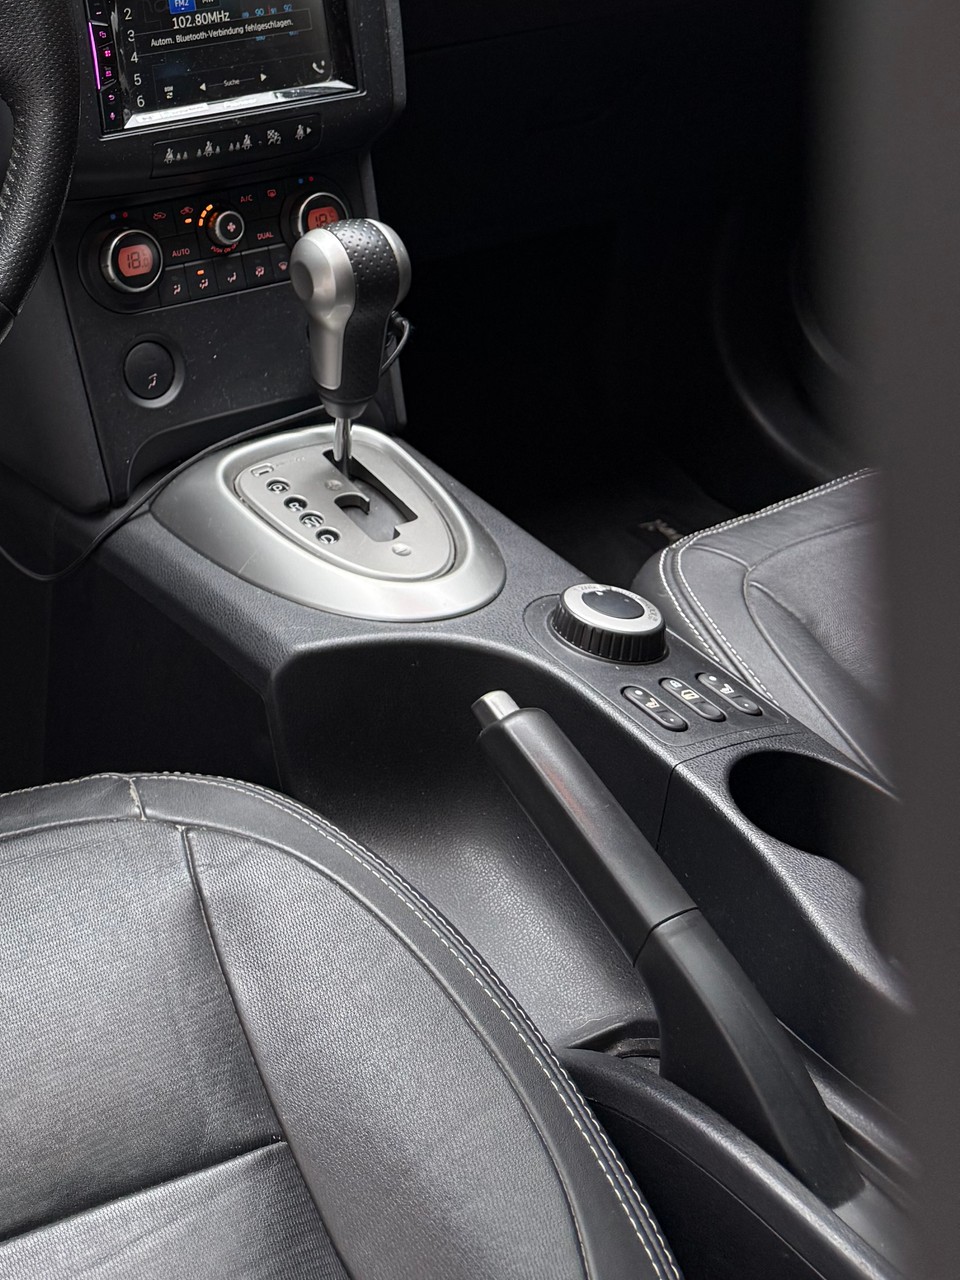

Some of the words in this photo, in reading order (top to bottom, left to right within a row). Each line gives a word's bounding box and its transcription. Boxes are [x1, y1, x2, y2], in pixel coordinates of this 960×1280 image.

[123, 8, 132, 20] 2
[255, 8, 264, 16] 90
[172, 10, 231, 29] 102.80MHz
[127, 29, 135, 42] 3
[151, 35, 175, 47] Autom.
[176, 24, 244, 43] Bluetooth-Verbindung
[245, 19, 294, 34] fehlgeschlagen.
[130, 51, 139, 63] 4
[134, 73, 142, 85] 5
[136, 95, 145, 108] 6
[240, 194, 253, 203] A/C
[257, 231, 274, 240] DUAL
[172, 248, 190, 258] AUTO
